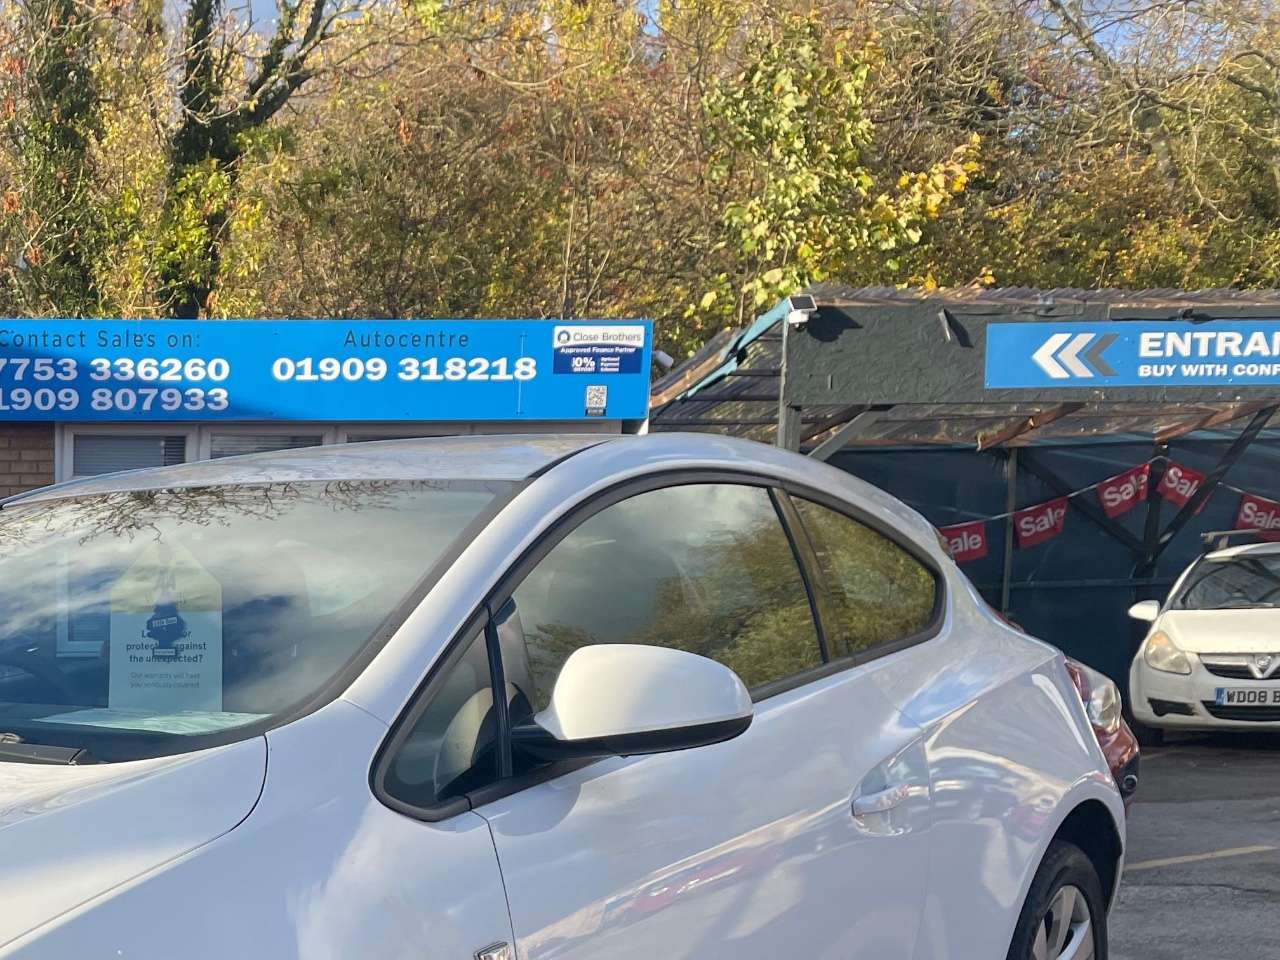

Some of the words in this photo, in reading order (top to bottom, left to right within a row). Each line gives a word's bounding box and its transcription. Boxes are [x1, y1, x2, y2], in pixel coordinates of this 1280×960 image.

[97, 329, 156, 348] Sales
[167, 332, 200, 348] on:
[343, 329, 470, 348] Autocentre
[573, 332, 599, 341] Close
[602, 332, 641, 341] Brothers
[89, 357, 231, 382] 336260
[272, 357, 388, 382] 01909
[397, 356, 538, 382] 318218
[1138, 364, 1177, 377] BUY
[1181, 364, 1228, 376] WITH
[90, 388, 230, 411] 807933
[1103, 474, 1148, 507] Sale
[1020, 508, 1065, 537] Sale
[1241, 502, 1280, 528] Sale
[943, 531, 982, 553] ale
[129, 654, 144, 663] the
[1226, 690, 1268, 703] WD08
